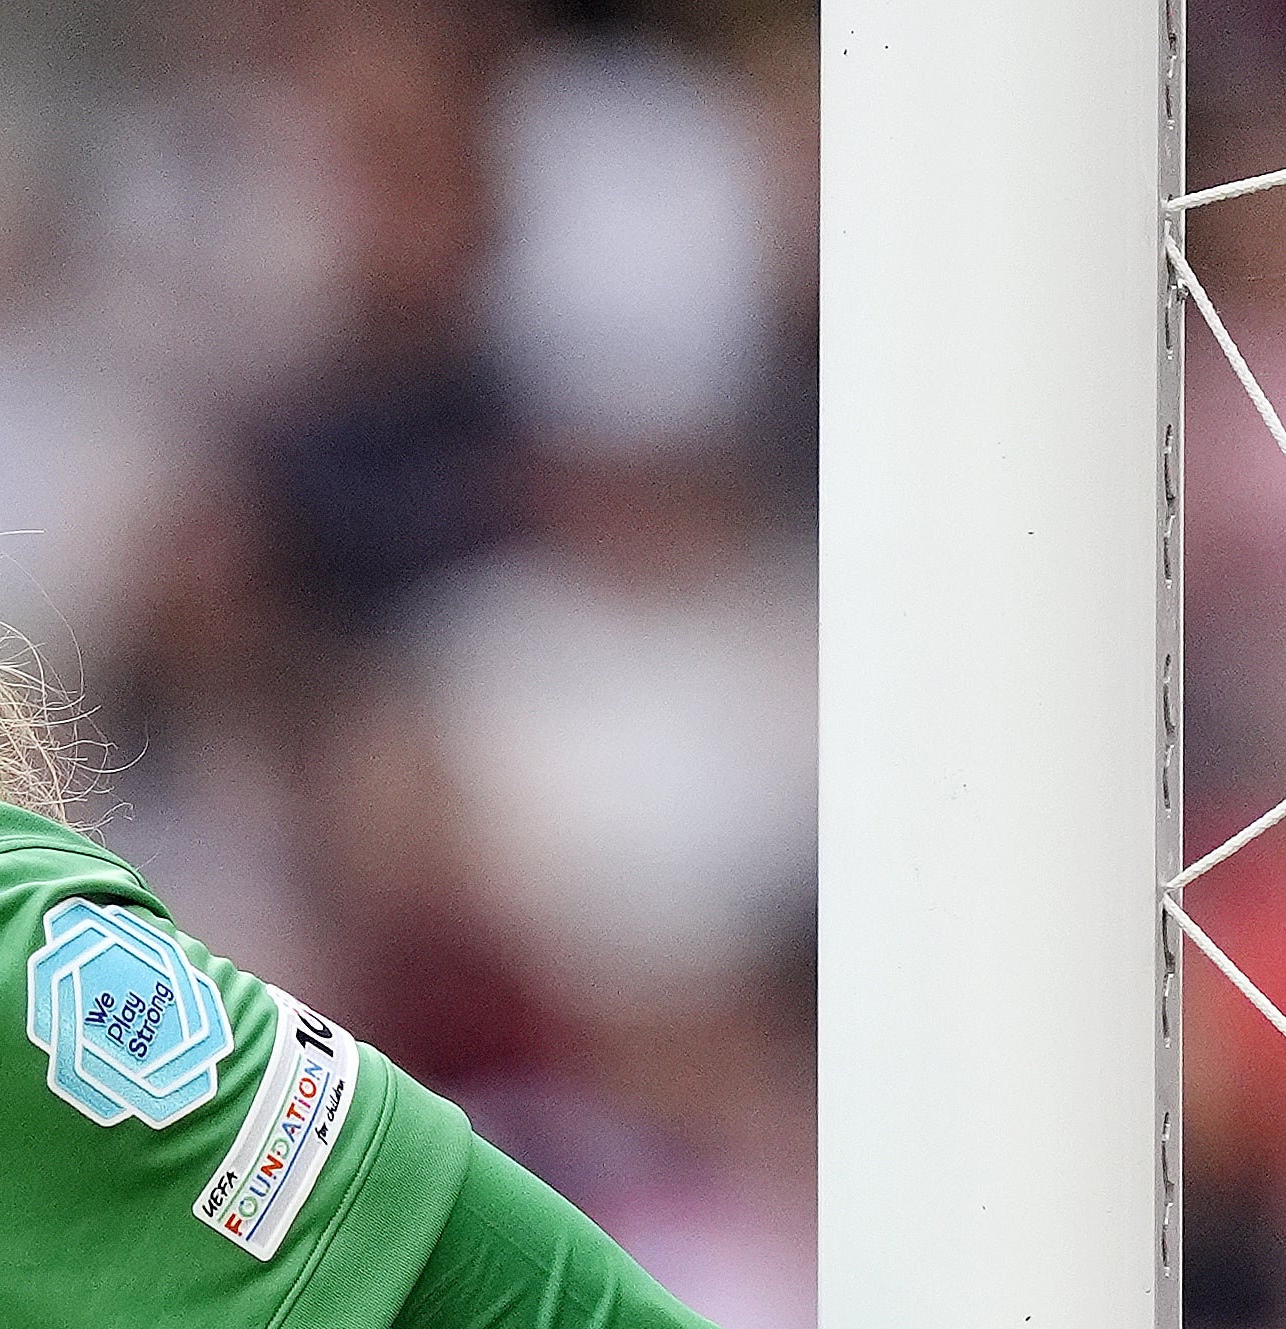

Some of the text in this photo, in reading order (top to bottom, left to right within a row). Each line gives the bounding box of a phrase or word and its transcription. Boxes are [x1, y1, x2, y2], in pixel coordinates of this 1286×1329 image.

[84, 992, 115, 1024] We
[107, 991, 146, 1045] Play
[128, 980, 175, 1058] Strong
[314, 1079, 346, 1146] for children
[202, 1170, 239, 1218] UEFA
